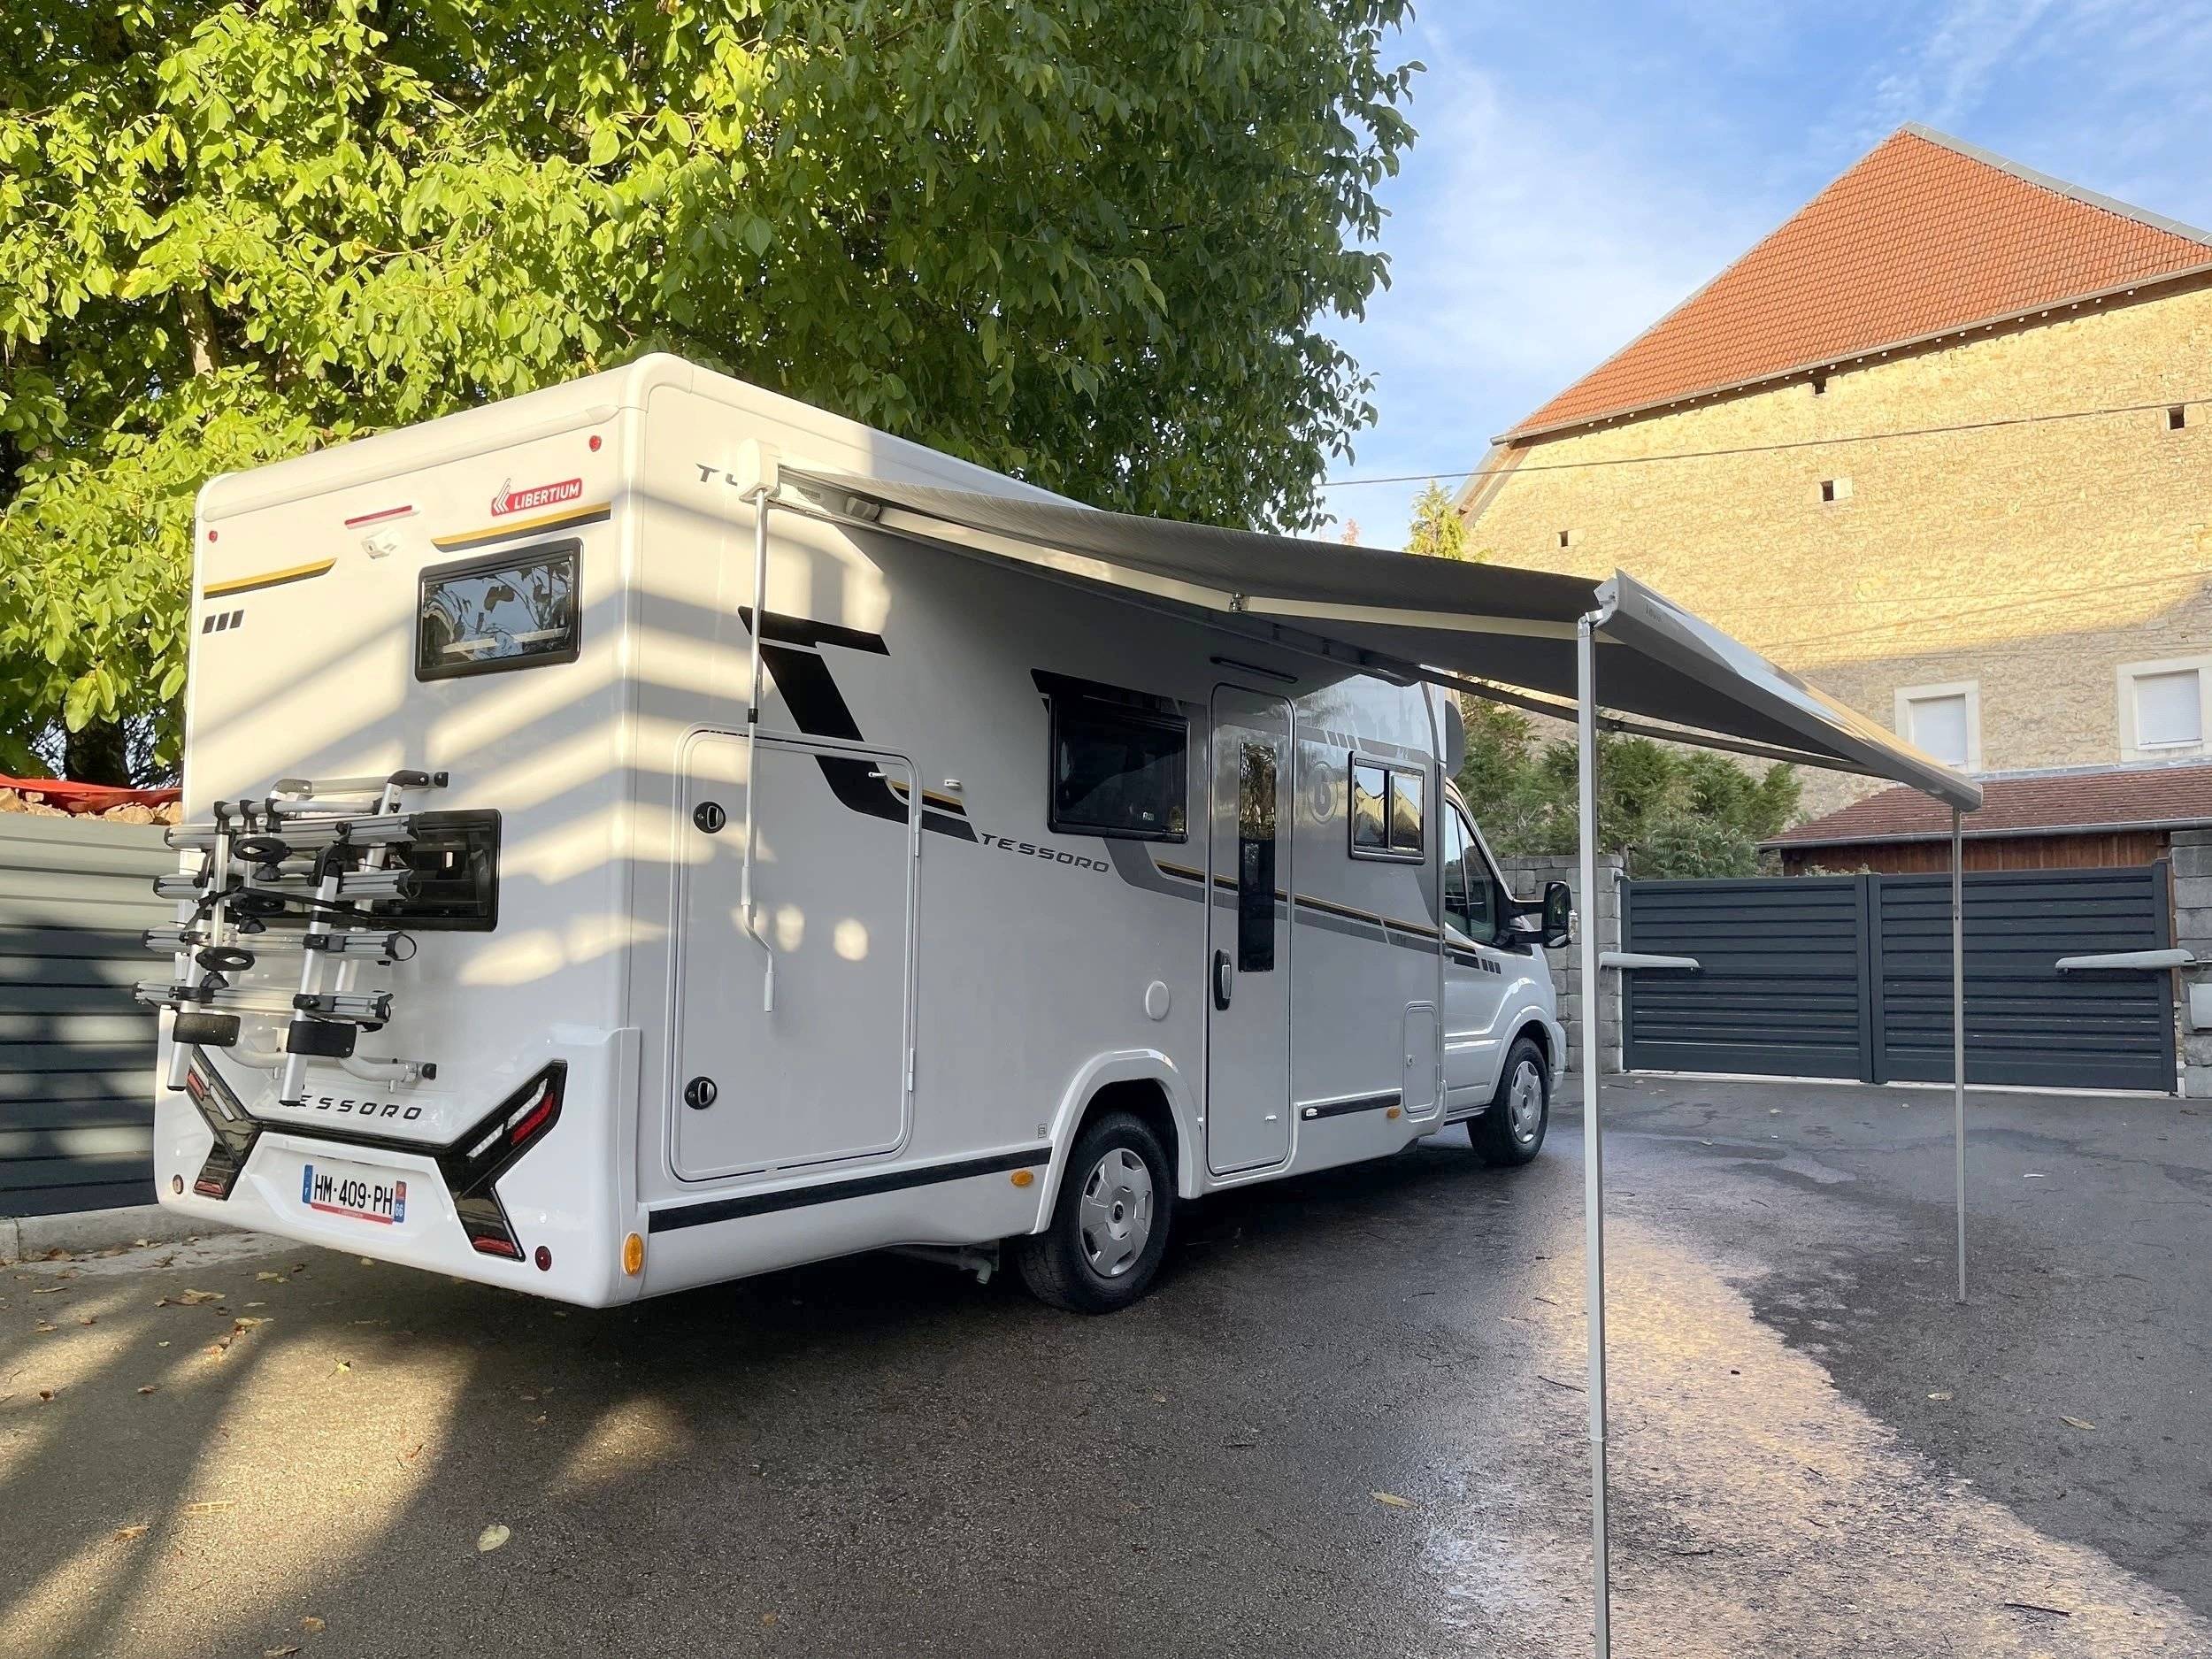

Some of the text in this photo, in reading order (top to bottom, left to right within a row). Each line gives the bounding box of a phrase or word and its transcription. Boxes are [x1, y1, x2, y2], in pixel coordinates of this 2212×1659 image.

[513, 481, 580, 511] LIBERTIUM
[980, 833, 1110, 872] TESSORO
[300, 1094, 423, 1120] ESSORO
[314, 1173, 394, 1215] HM-409-PH
